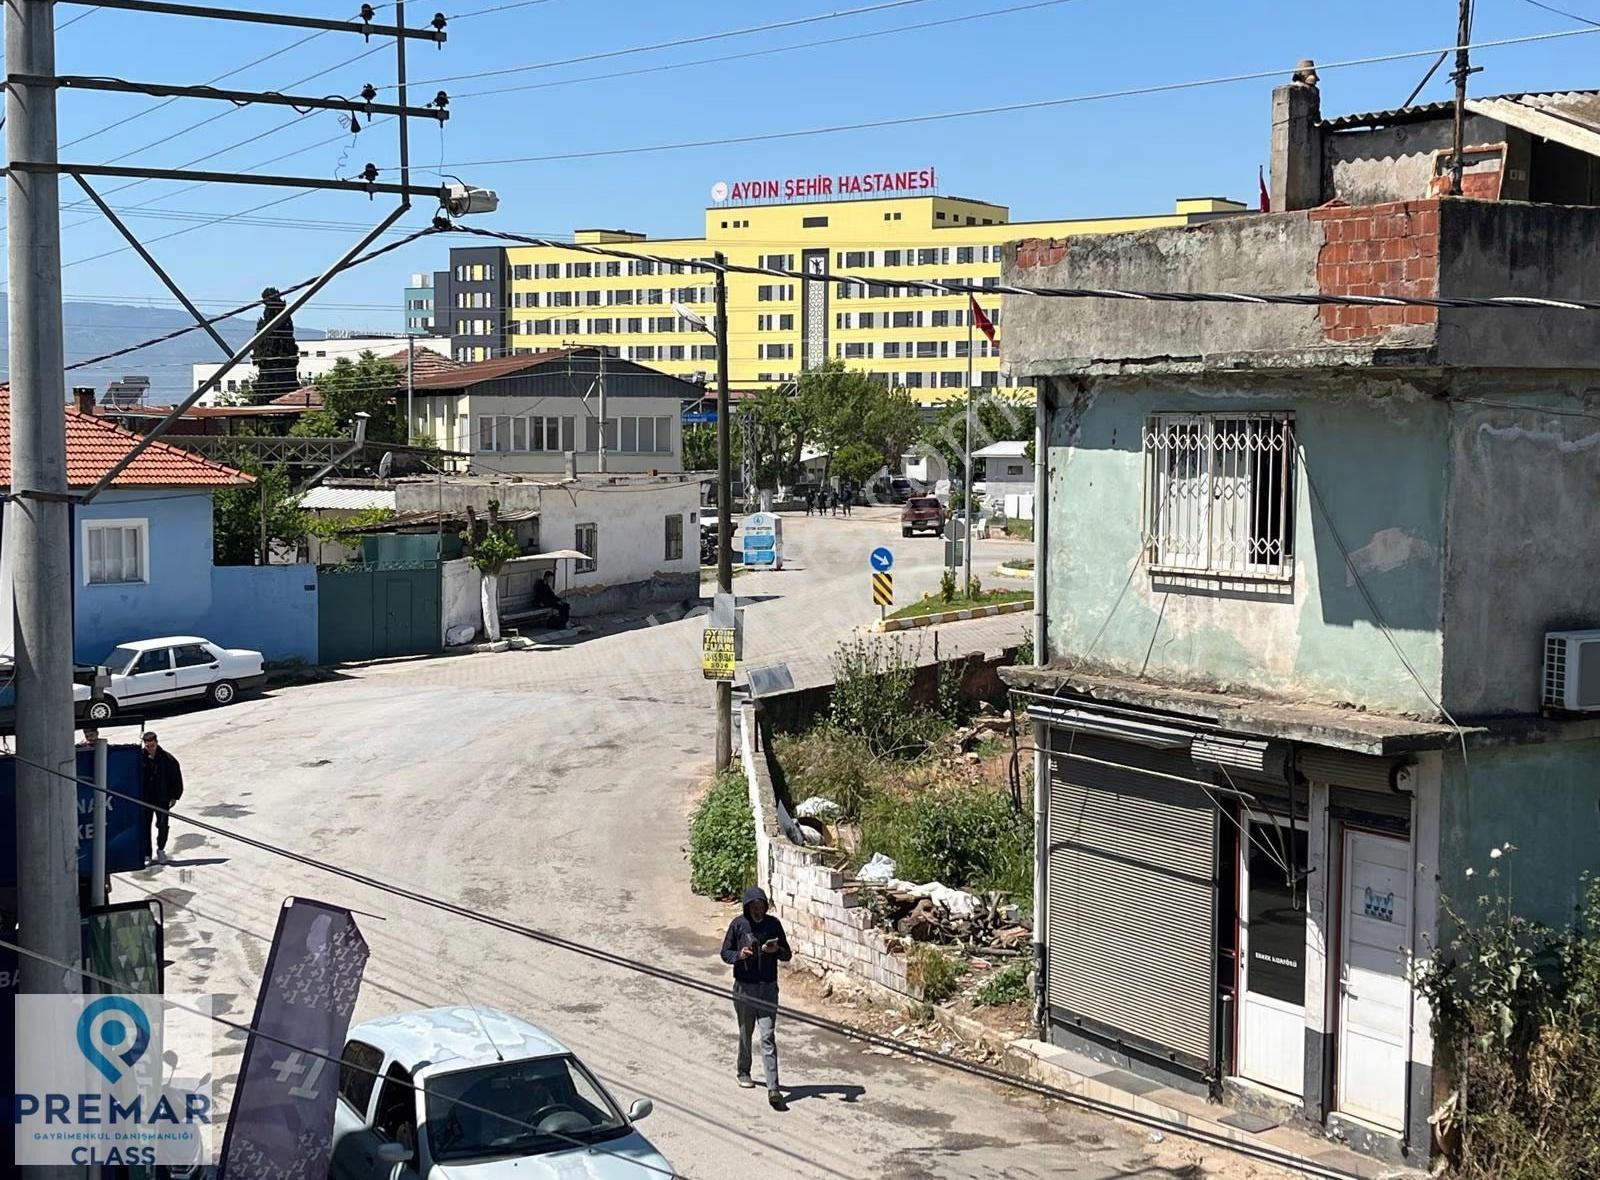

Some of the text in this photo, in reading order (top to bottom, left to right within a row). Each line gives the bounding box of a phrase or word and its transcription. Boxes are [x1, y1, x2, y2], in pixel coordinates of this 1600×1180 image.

[731, 167, 935, 200] AYDIN ŞEHİR HASTANESİ
[270, 1047, 329, 1100] +1
